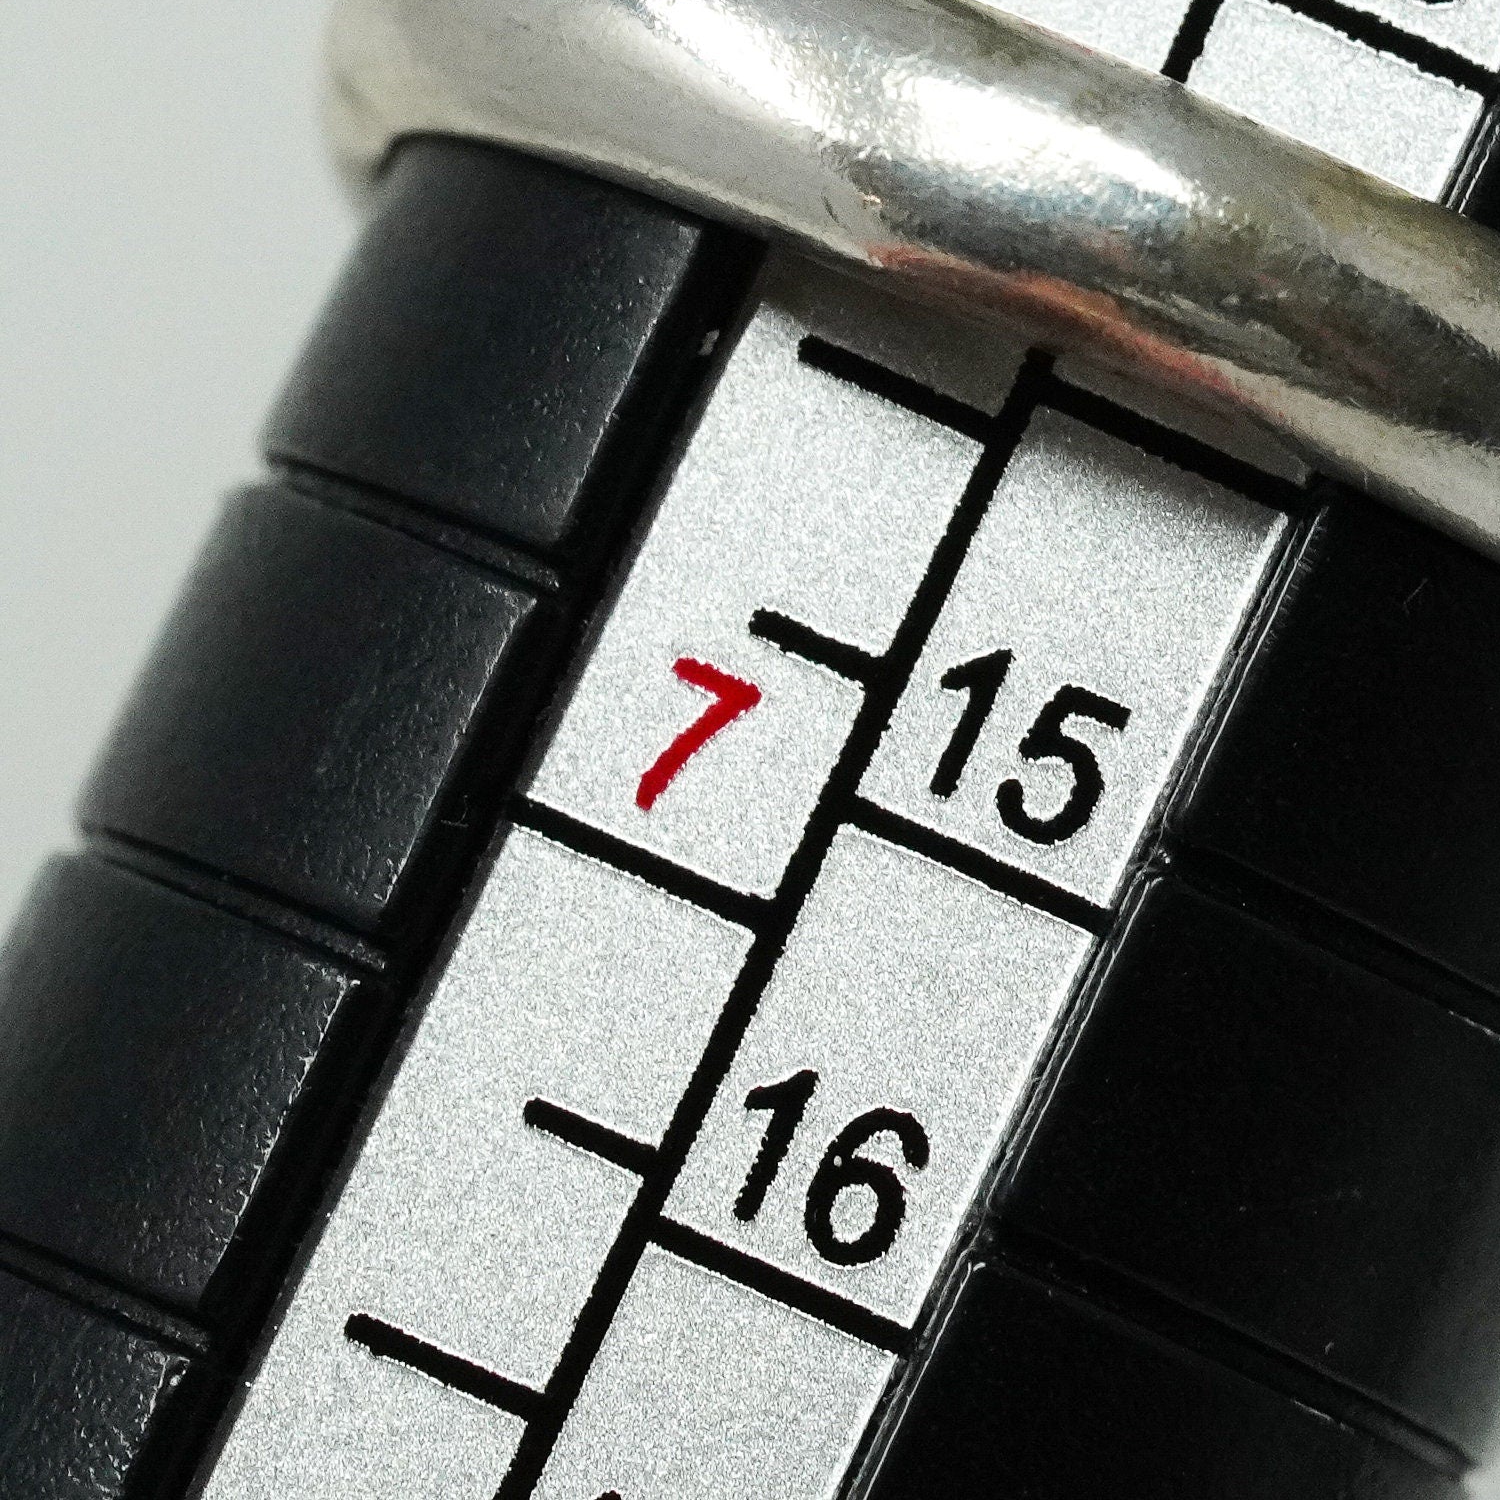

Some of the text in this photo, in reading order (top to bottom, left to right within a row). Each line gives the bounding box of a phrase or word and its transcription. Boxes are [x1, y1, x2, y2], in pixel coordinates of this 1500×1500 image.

[635, 658, 762, 812] 7
[929, 649, 1132, 846] 15
[732, 1069, 930, 1267] 16
